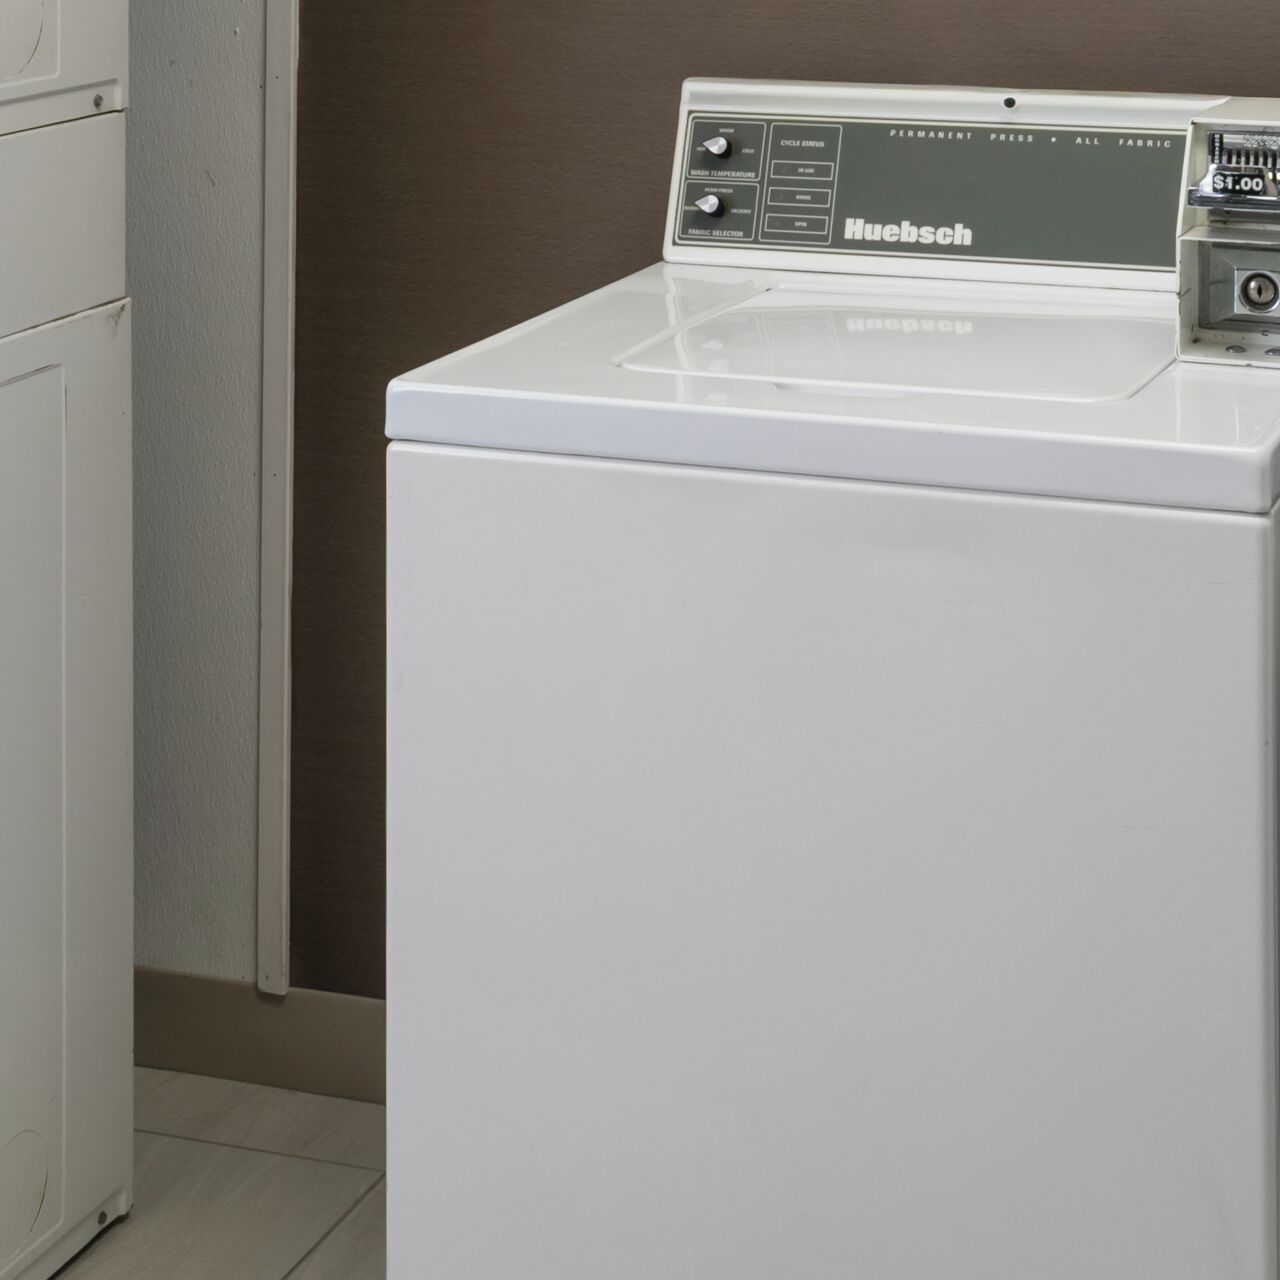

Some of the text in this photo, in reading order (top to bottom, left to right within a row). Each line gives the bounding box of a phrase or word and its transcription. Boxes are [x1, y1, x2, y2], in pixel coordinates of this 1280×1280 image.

[801, 140, 825, 148] STATUS
[889, 129, 1173, 148] PERMANENT PRESS ALL FABRIC
[711, 170, 756, 178] TEMPERATURE
[1213, 174, 1264, 191] $1.00
[688, 228, 744, 237] FABRIC SELECTOR
[844, 217, 973, 246] Huebsch
